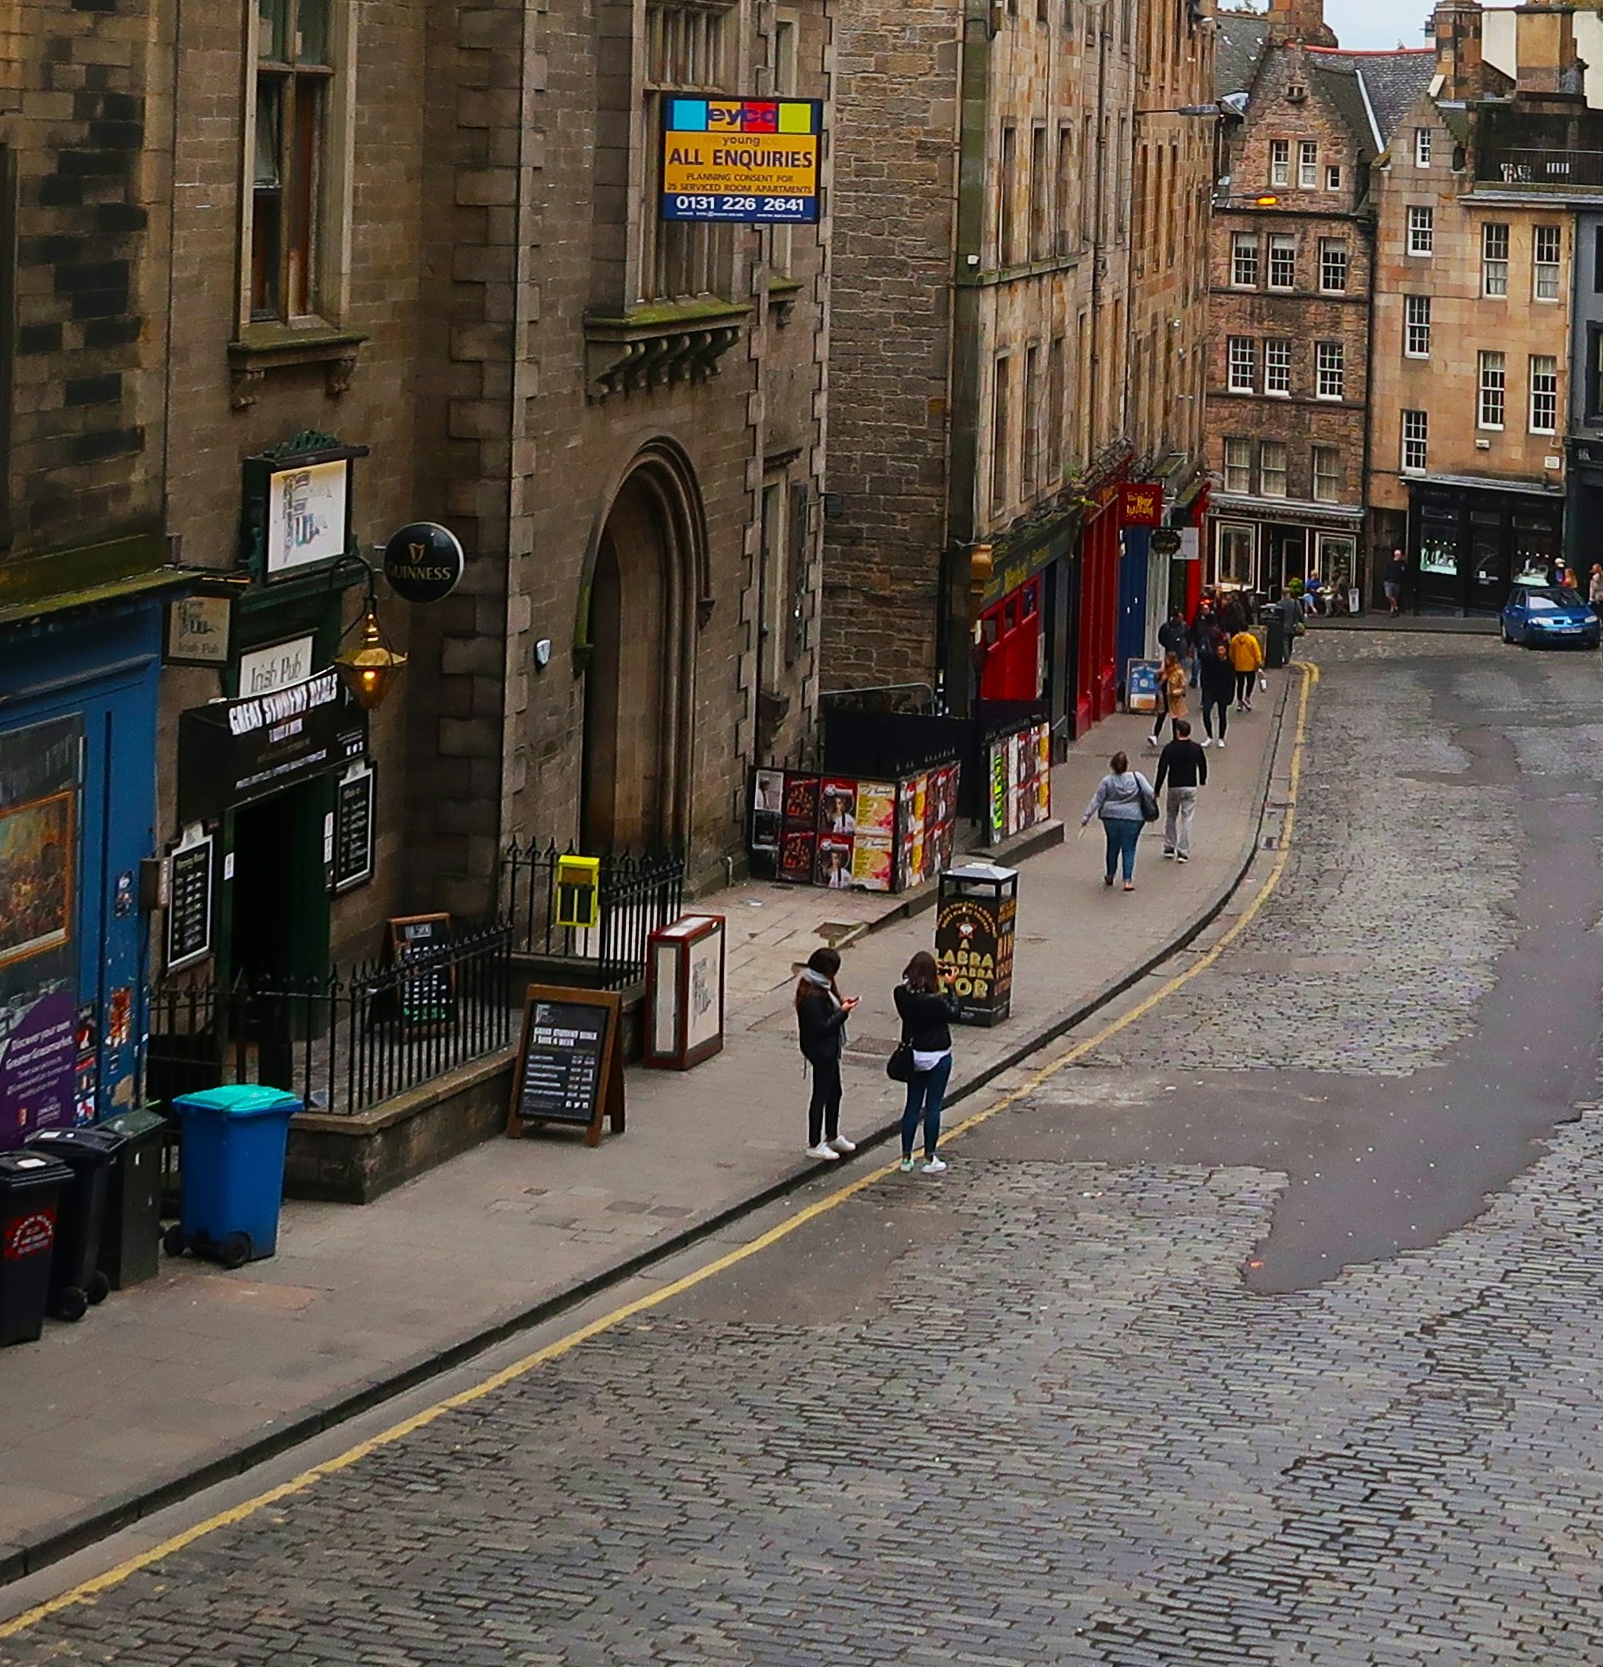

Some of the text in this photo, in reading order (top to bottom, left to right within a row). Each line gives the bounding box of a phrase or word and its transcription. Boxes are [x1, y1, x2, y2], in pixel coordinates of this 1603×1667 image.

[722, 136, 761, 147] young
[668, 148, 813, 170] ALL ENQUIRIES
[686, 173, 794, 183] PLANNING CONSENT FOR
[667, 182, 813, 194] 25 SERVICED ROOM APARTMENTS
[676, 196, 804, 212] 0131 226 2641
[391, 565, 452, 581] GUINNESS
[250, 650, 302, 692] Irish Pub
[229, 703, 263, 736] GREAT
[263, 684, 308, 724] STUDENT
